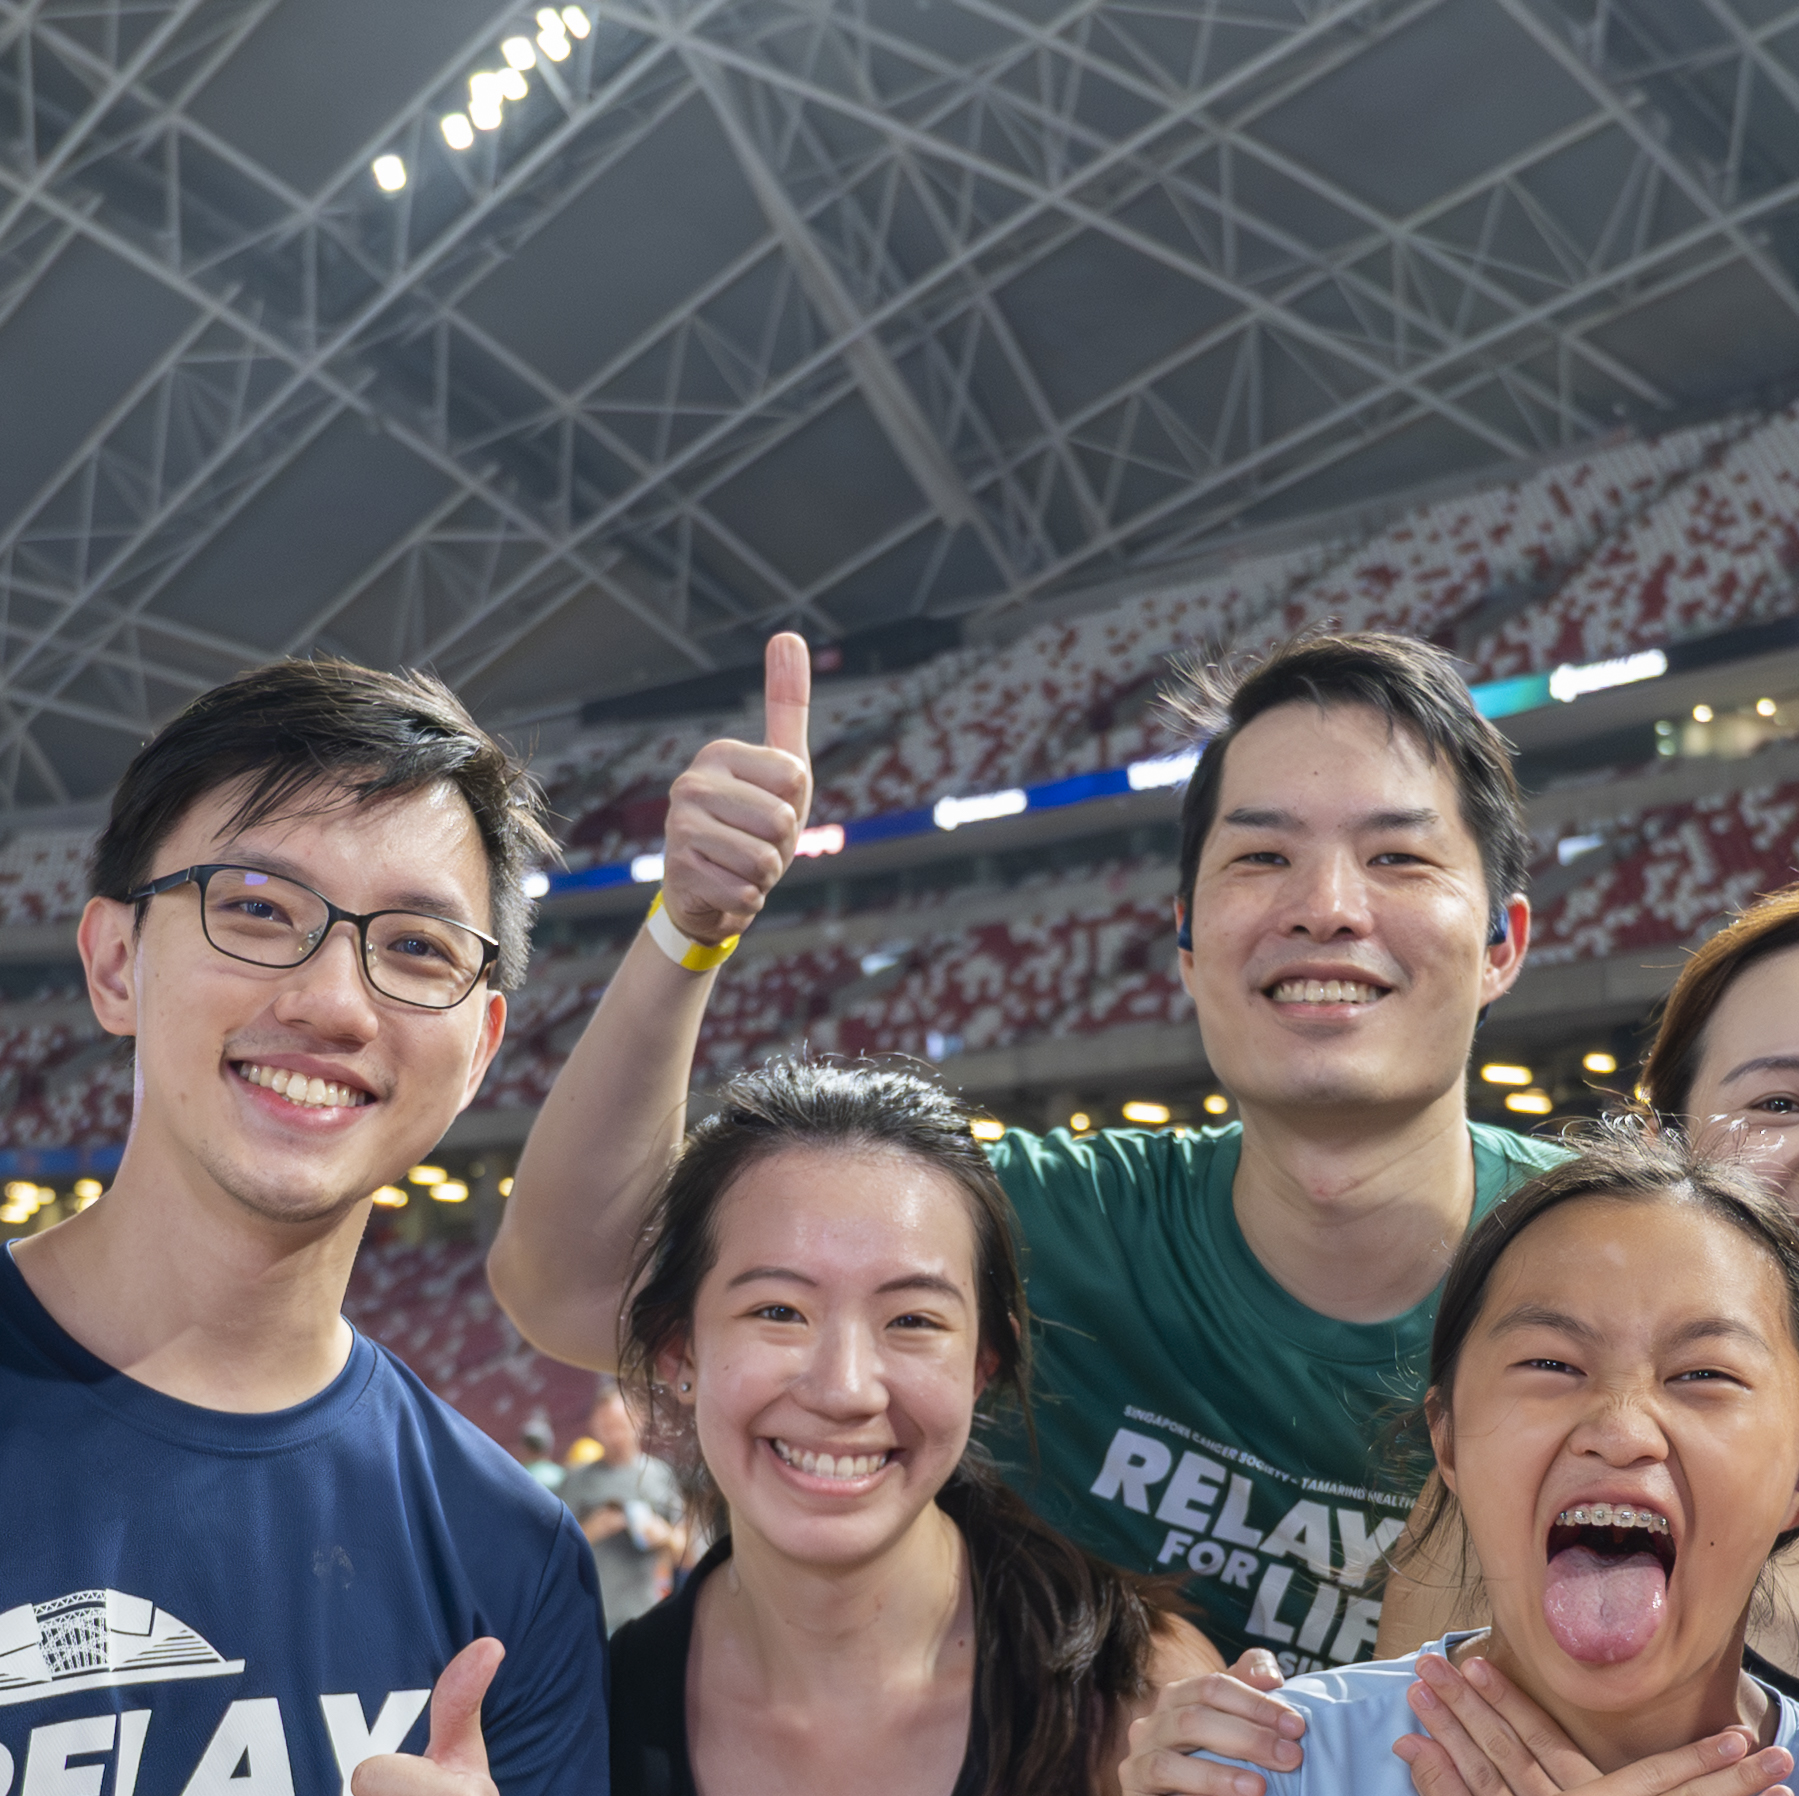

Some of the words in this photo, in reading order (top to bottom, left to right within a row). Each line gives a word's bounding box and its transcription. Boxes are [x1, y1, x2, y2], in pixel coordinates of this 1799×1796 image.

[1090, 1428, 1406, 1589] RELAY
[1301, 1477, 1365, 1501] TAMARIND
[1156, 1530, 1260, 1589] FOR
[1244, 1562, 1383, 1664] LIF
